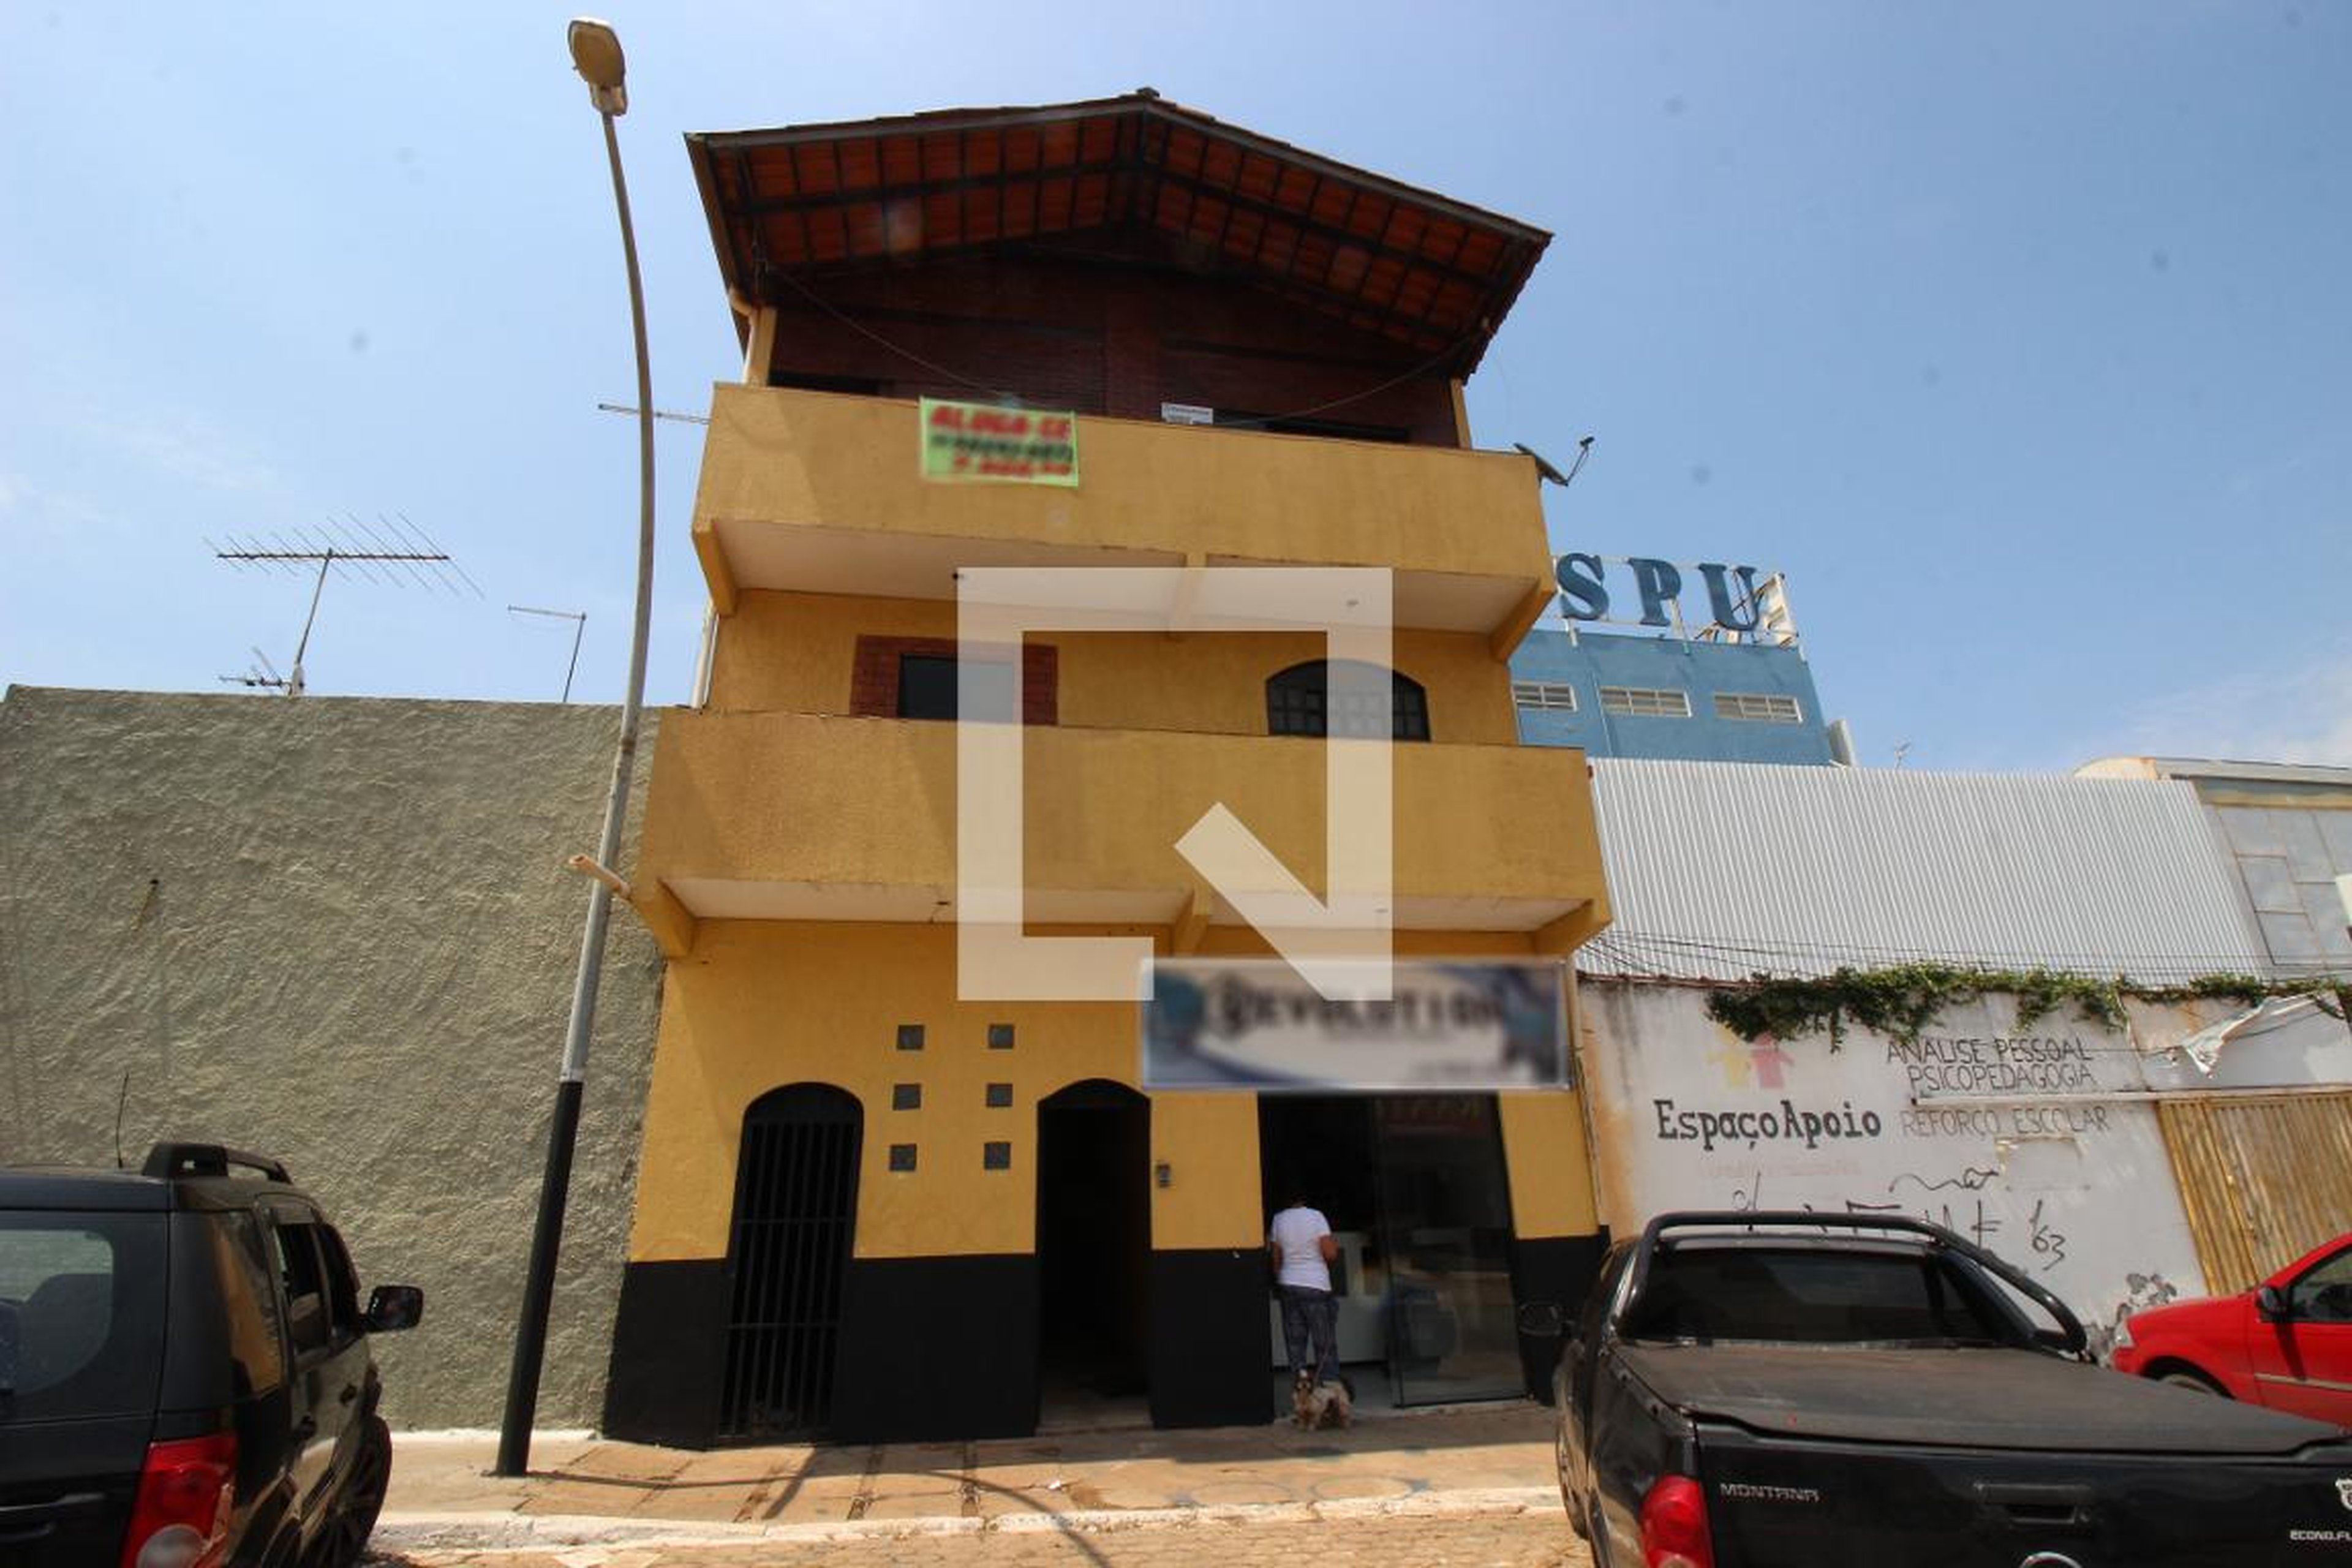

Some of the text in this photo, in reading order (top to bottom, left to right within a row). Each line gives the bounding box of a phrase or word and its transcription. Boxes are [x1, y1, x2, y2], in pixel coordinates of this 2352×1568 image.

[1994, 1036, 2093, 1063] PESSOAL
[1908, 1063, 2097, 1091] PSICOPEDAGOGIA
[1654, 1099, 1881, 1151] Espaço Apoio
[2013, 1105, 2109, 1134] ESCOLAR
[1720, 1483, 1820, 1502] MONTANA
